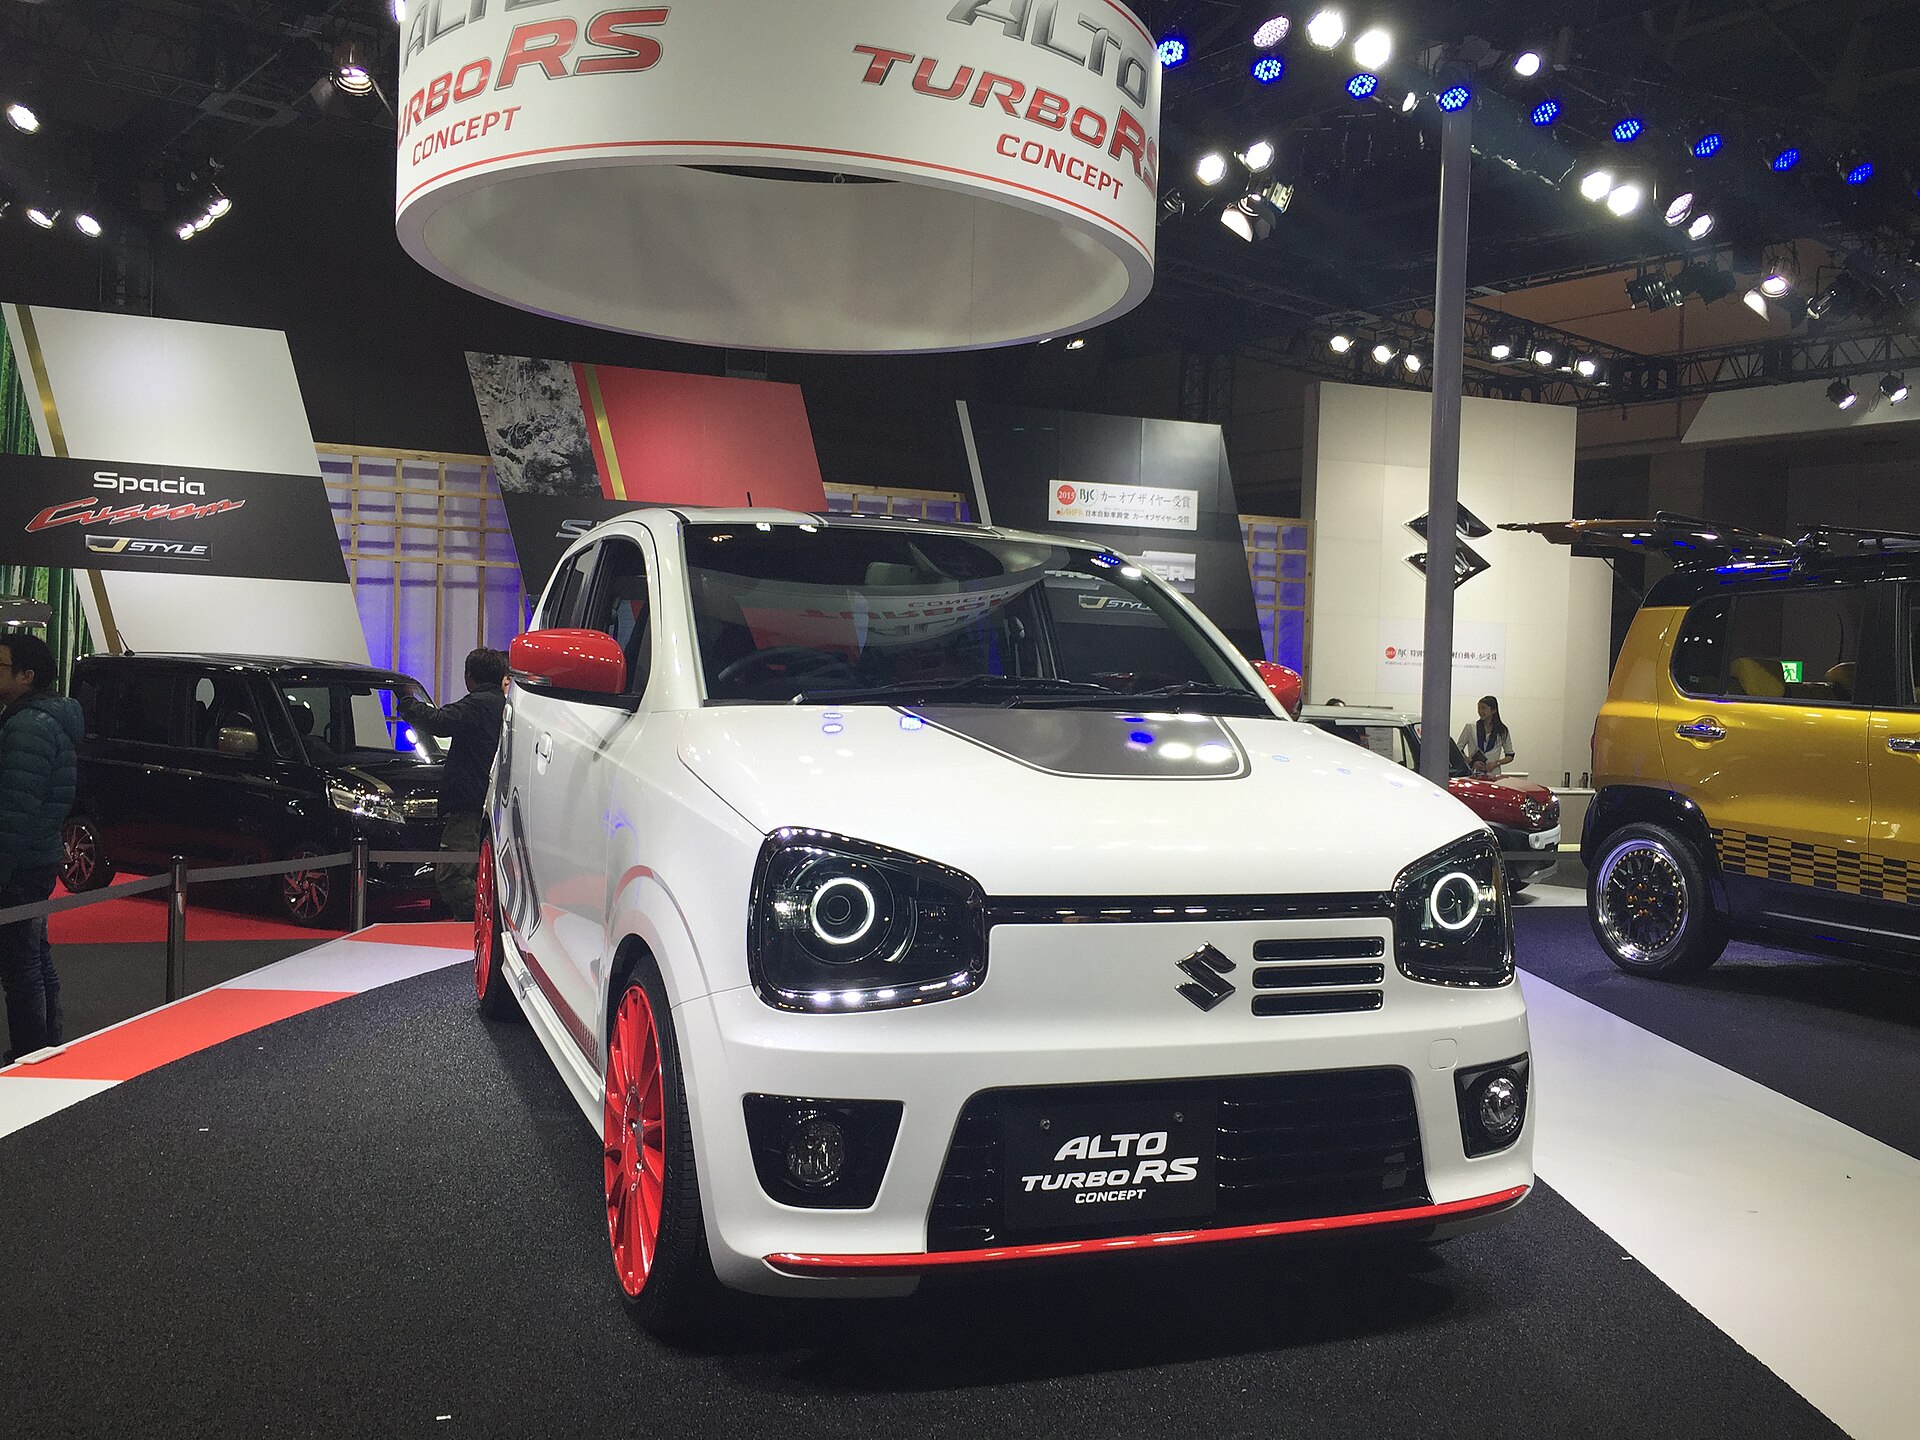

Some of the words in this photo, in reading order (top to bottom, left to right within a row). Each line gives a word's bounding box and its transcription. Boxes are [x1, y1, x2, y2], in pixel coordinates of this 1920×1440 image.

[494, 6, 671, 91] RS
[853, 43, 1107, 149] TURBO
[413, 106, 522, 167] CONCEPT
[996, 133, 1124, 200] CONCEPT
[93, 471, 206, 496] Spacia
[24, 497, 246, 533] Custom
[1054, 1131, 1168, 1161] ALTO
[1022, 1169, 1131, 1192] TURBO
[1132, 1157, 1199, 1185] RS
[1075, 1189, 1147, 1204] CONCEPT
